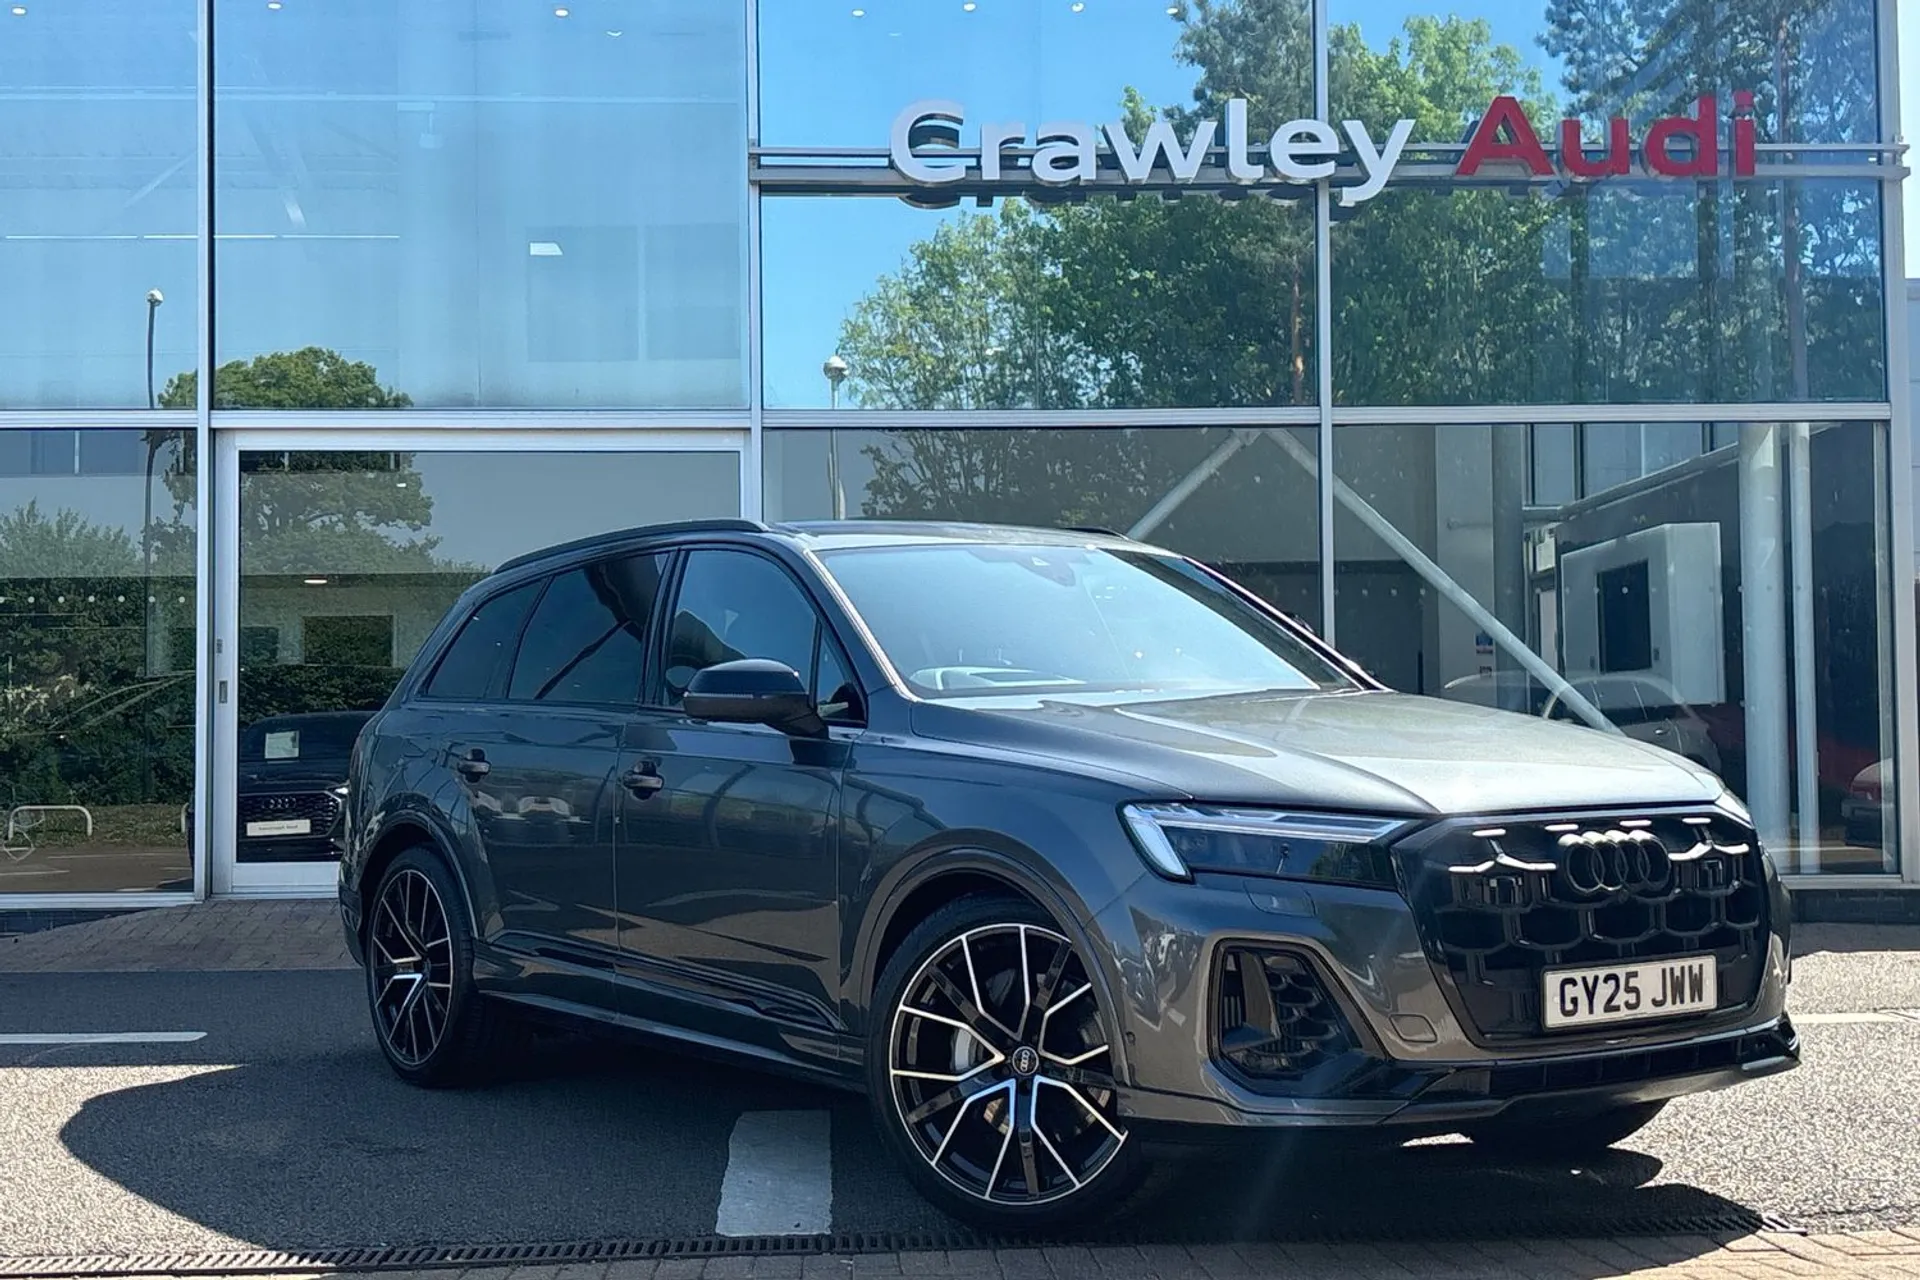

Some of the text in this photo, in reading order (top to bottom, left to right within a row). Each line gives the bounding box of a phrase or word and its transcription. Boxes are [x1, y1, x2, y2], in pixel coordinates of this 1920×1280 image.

[891, 89, 1756, 206] Crawley Audi
[1559, 963, 1704, 1017] GY25 JWW
